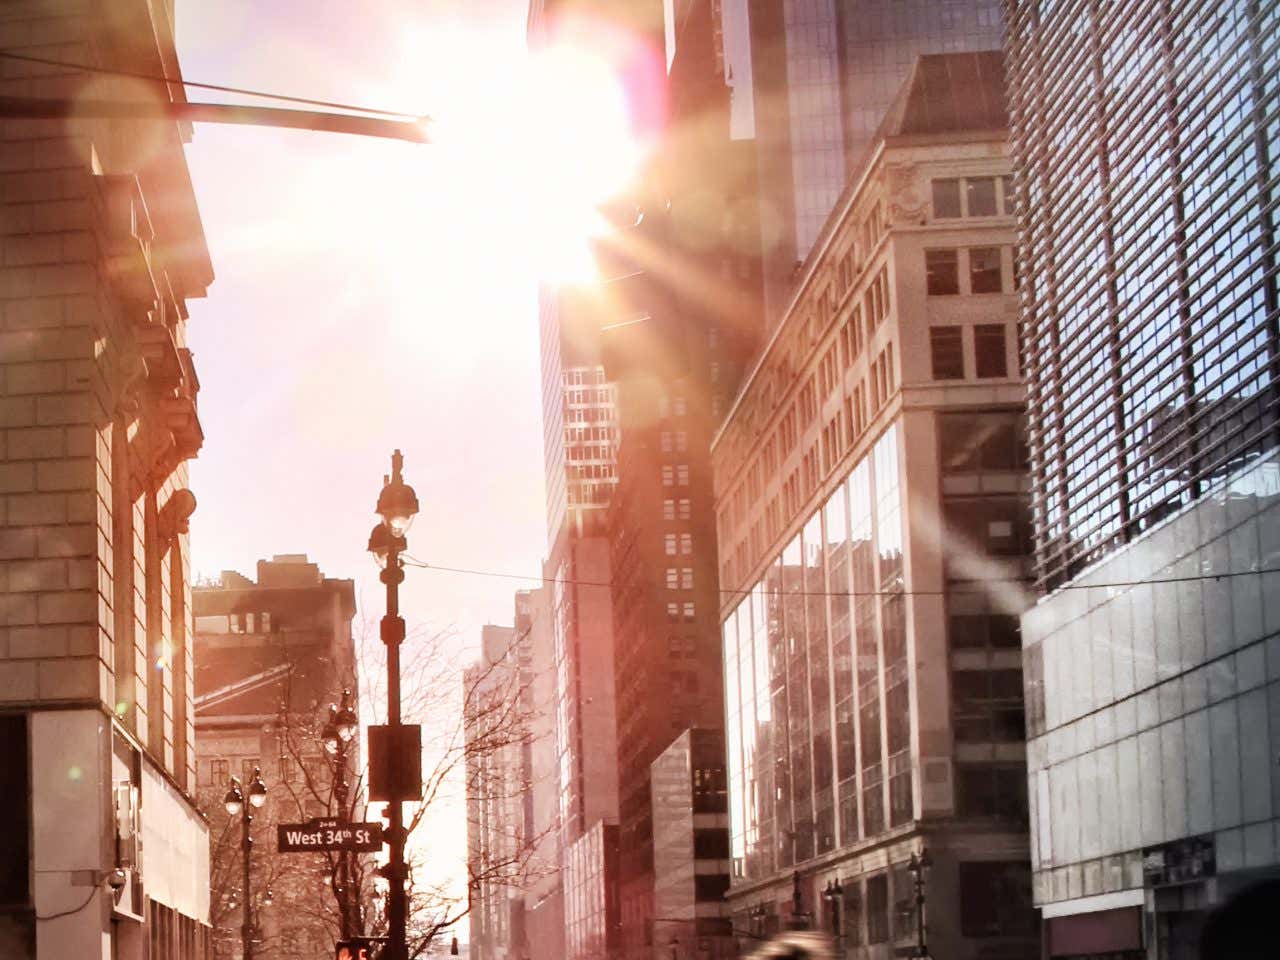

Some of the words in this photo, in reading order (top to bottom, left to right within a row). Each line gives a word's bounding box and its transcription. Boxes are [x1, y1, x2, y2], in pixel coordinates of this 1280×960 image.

[287, 831, 322, 845] West
[326, 828, 352, 844] 34th
[355, 829, 370, 844] St
